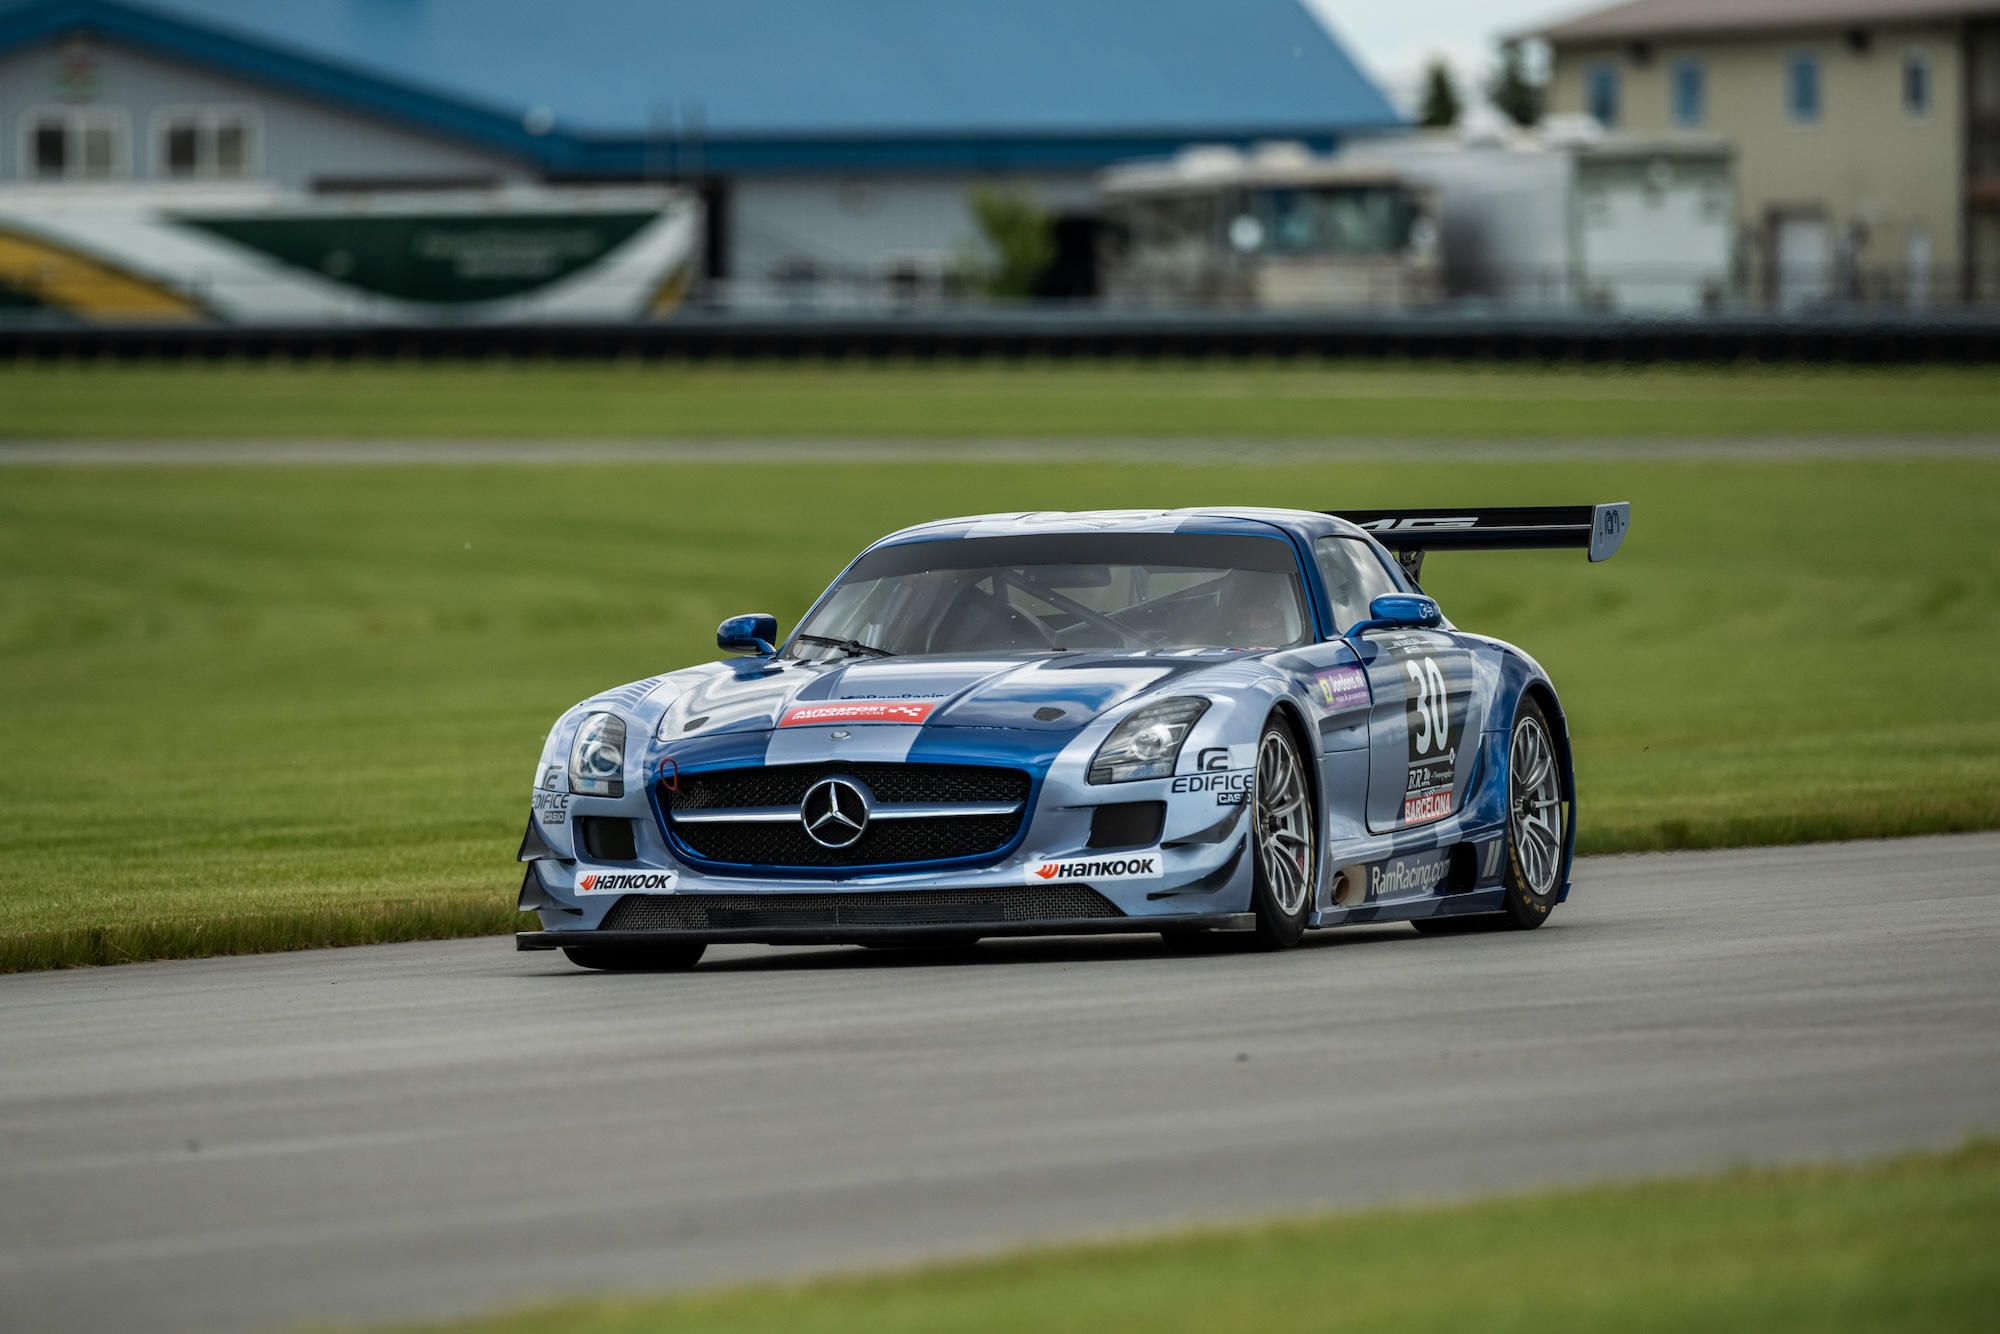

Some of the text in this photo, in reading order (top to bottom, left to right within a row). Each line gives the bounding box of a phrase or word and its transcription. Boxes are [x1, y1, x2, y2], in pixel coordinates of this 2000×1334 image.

[794, 706, 888, 716] AUTOSPORT
[1406, 656, 1448, 754] 30
[1171, 774, 1253, 793] EDIFICE
[544, 812, 565, 822] CASIO
[1404, 794, 1452, 822] BARCELONA
[1371, 858, 1450, 896] RamRacing.com
